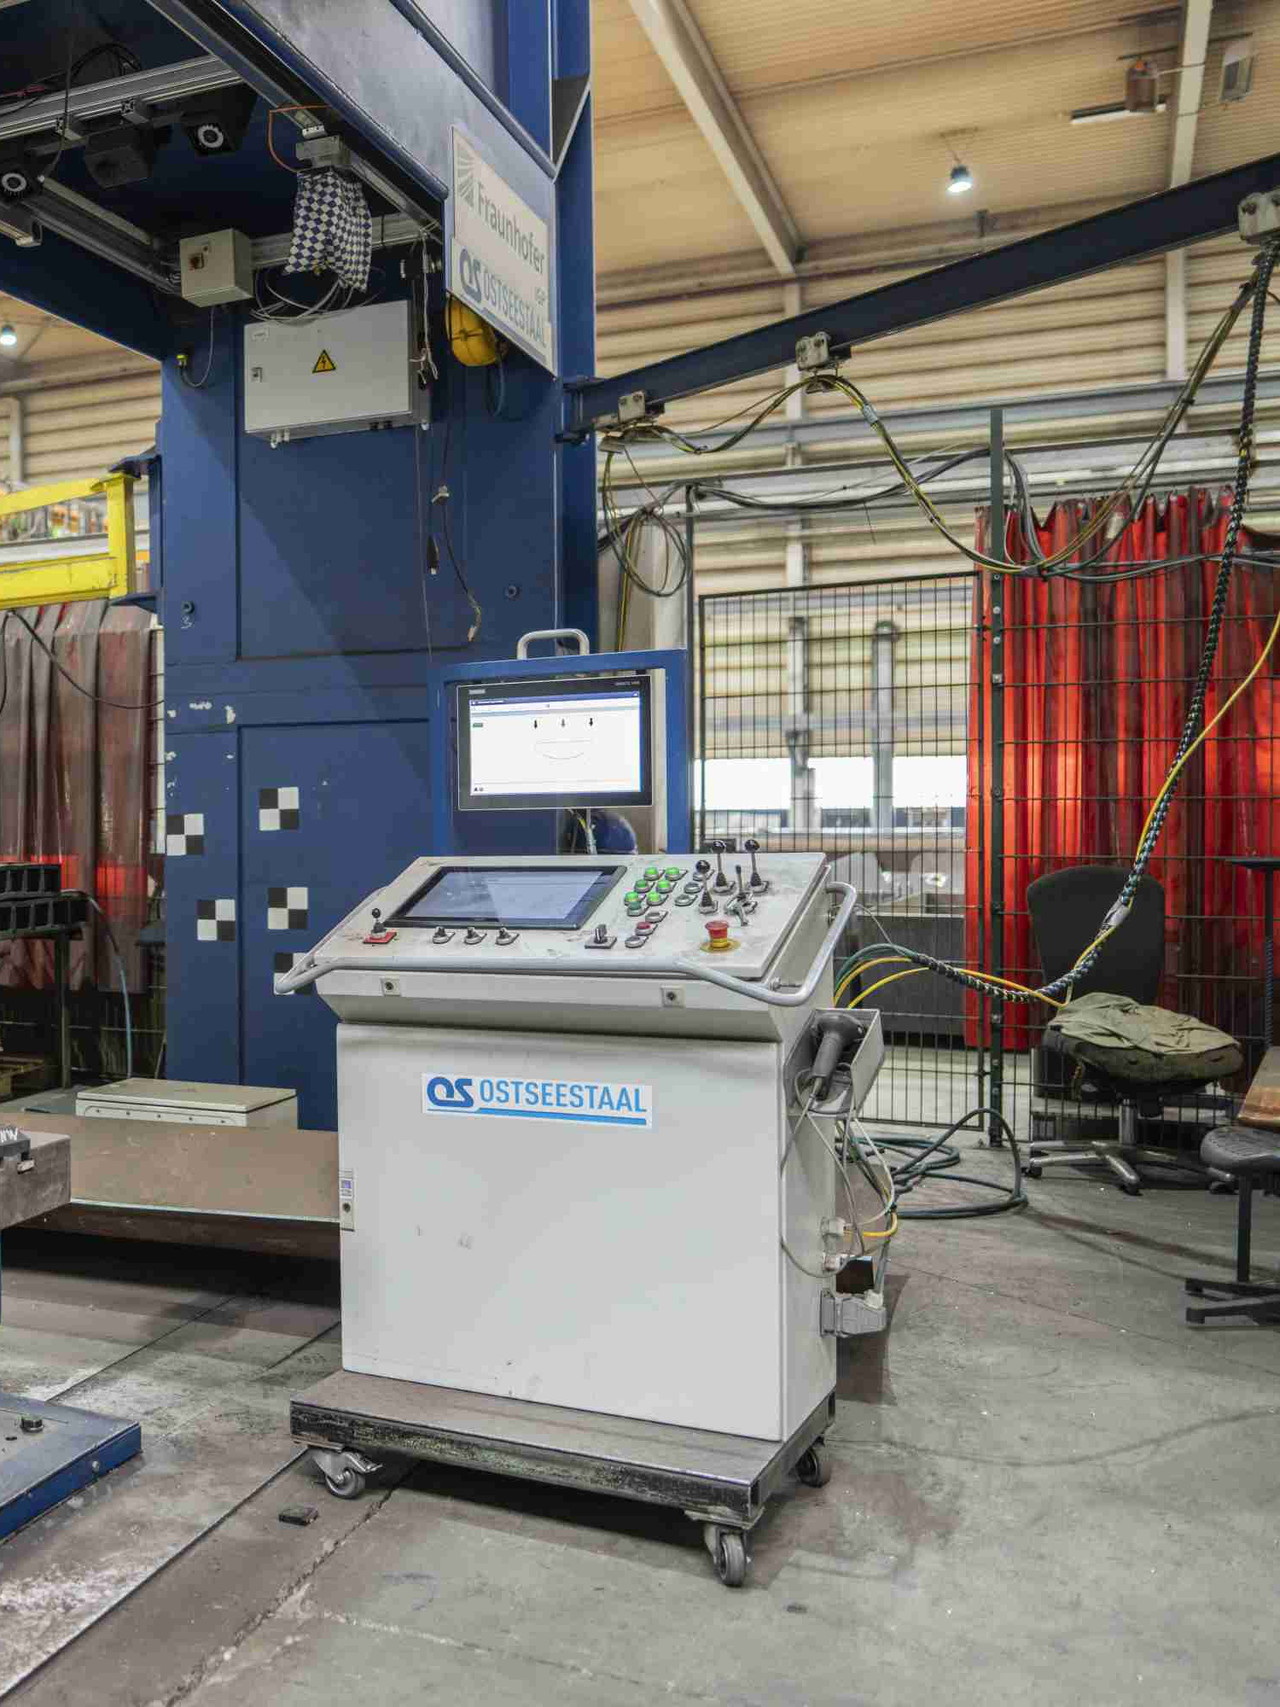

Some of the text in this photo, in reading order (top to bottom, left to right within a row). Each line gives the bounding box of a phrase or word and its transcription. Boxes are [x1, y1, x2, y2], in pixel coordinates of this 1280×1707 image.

[477, 181, 545, 275] Fraunhofer
[483, 270, 547, 348] OSTSEESTAAL
[479, 1079, 648, 1113] OSTSEESTAAL
